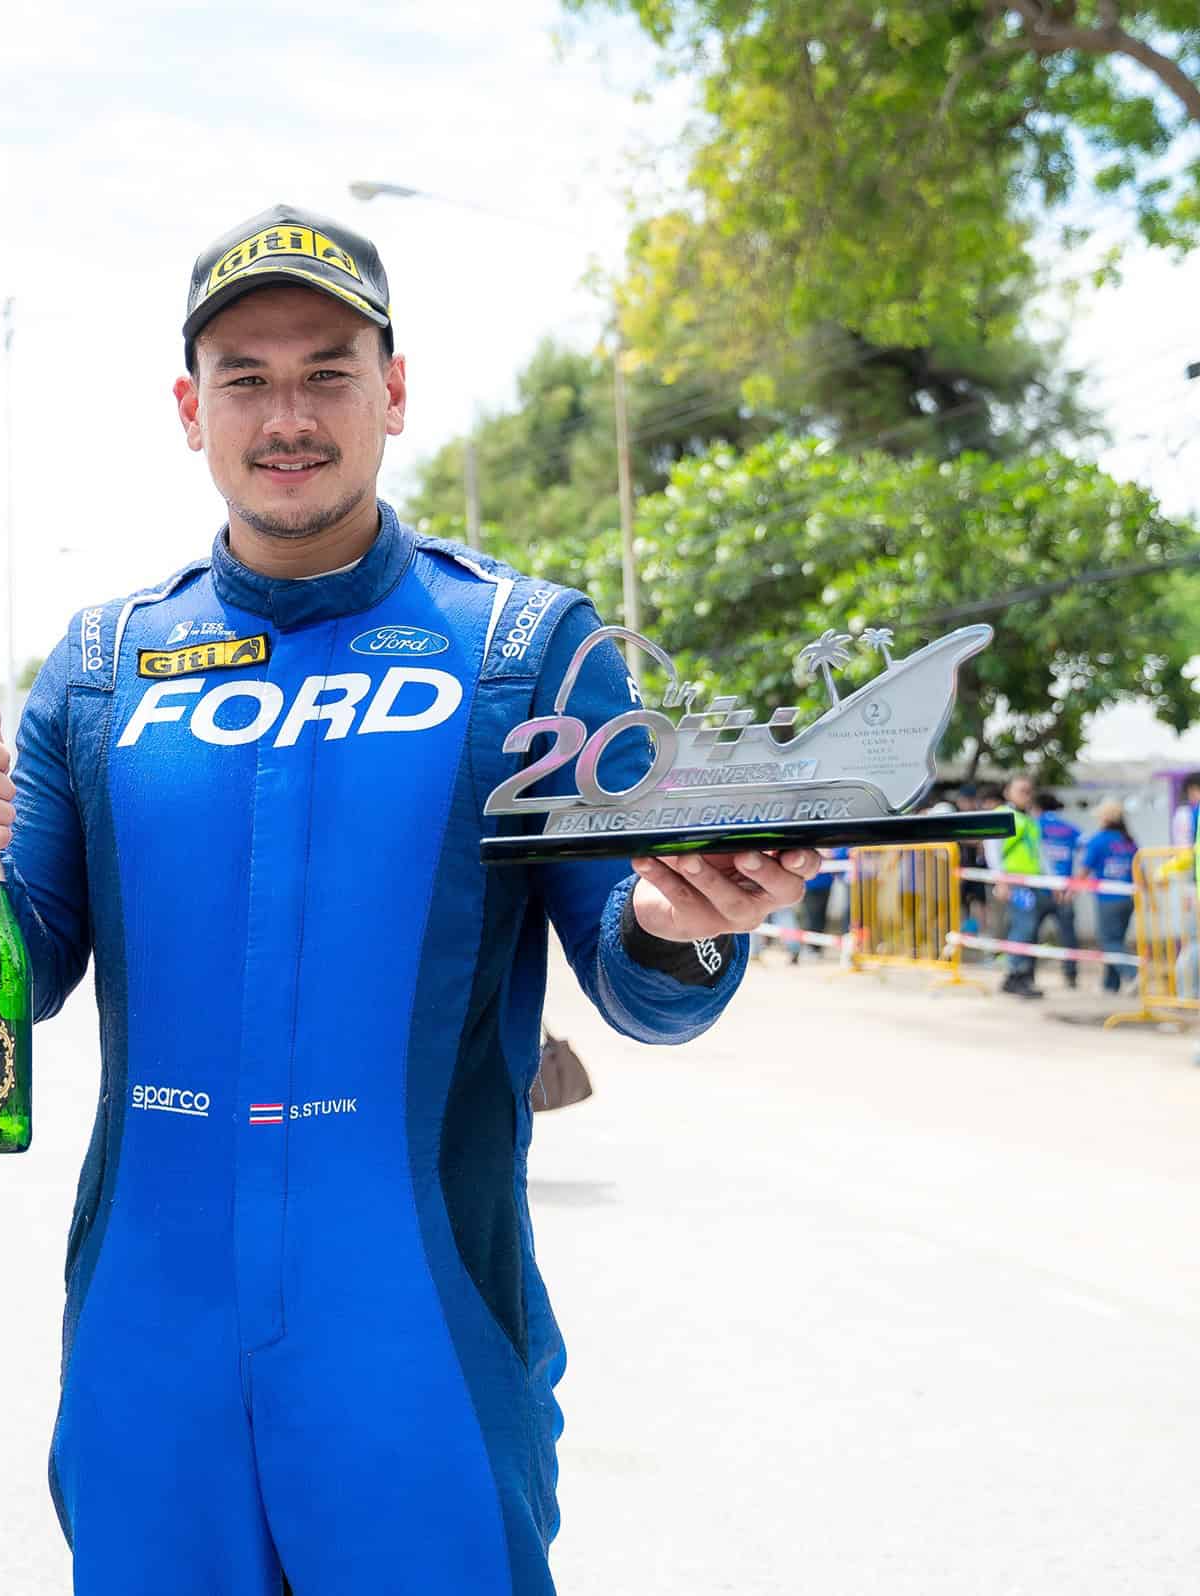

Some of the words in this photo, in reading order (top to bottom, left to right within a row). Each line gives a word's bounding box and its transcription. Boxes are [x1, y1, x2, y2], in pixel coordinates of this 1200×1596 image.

[217, 231, 303, 277] Giti
[84, 608, 104, 671] sparco
[370, 628, 427, 651] Ford
[502, 590, 554, 659] sparco
[144, 647, 217, 673] Giti
[116, 666, 463, 748] FORD
[674, 761, 810, 785] ANNIVERSARY
[557, 807, 691, 833] BANGSAEN
[701, 802, 785, 825] GRAND
[792, 797, 851, 821] PRIX
[132, 1085, 210, 1113] sparco
[289, 1098, 357, 1120] S.STUVIK
